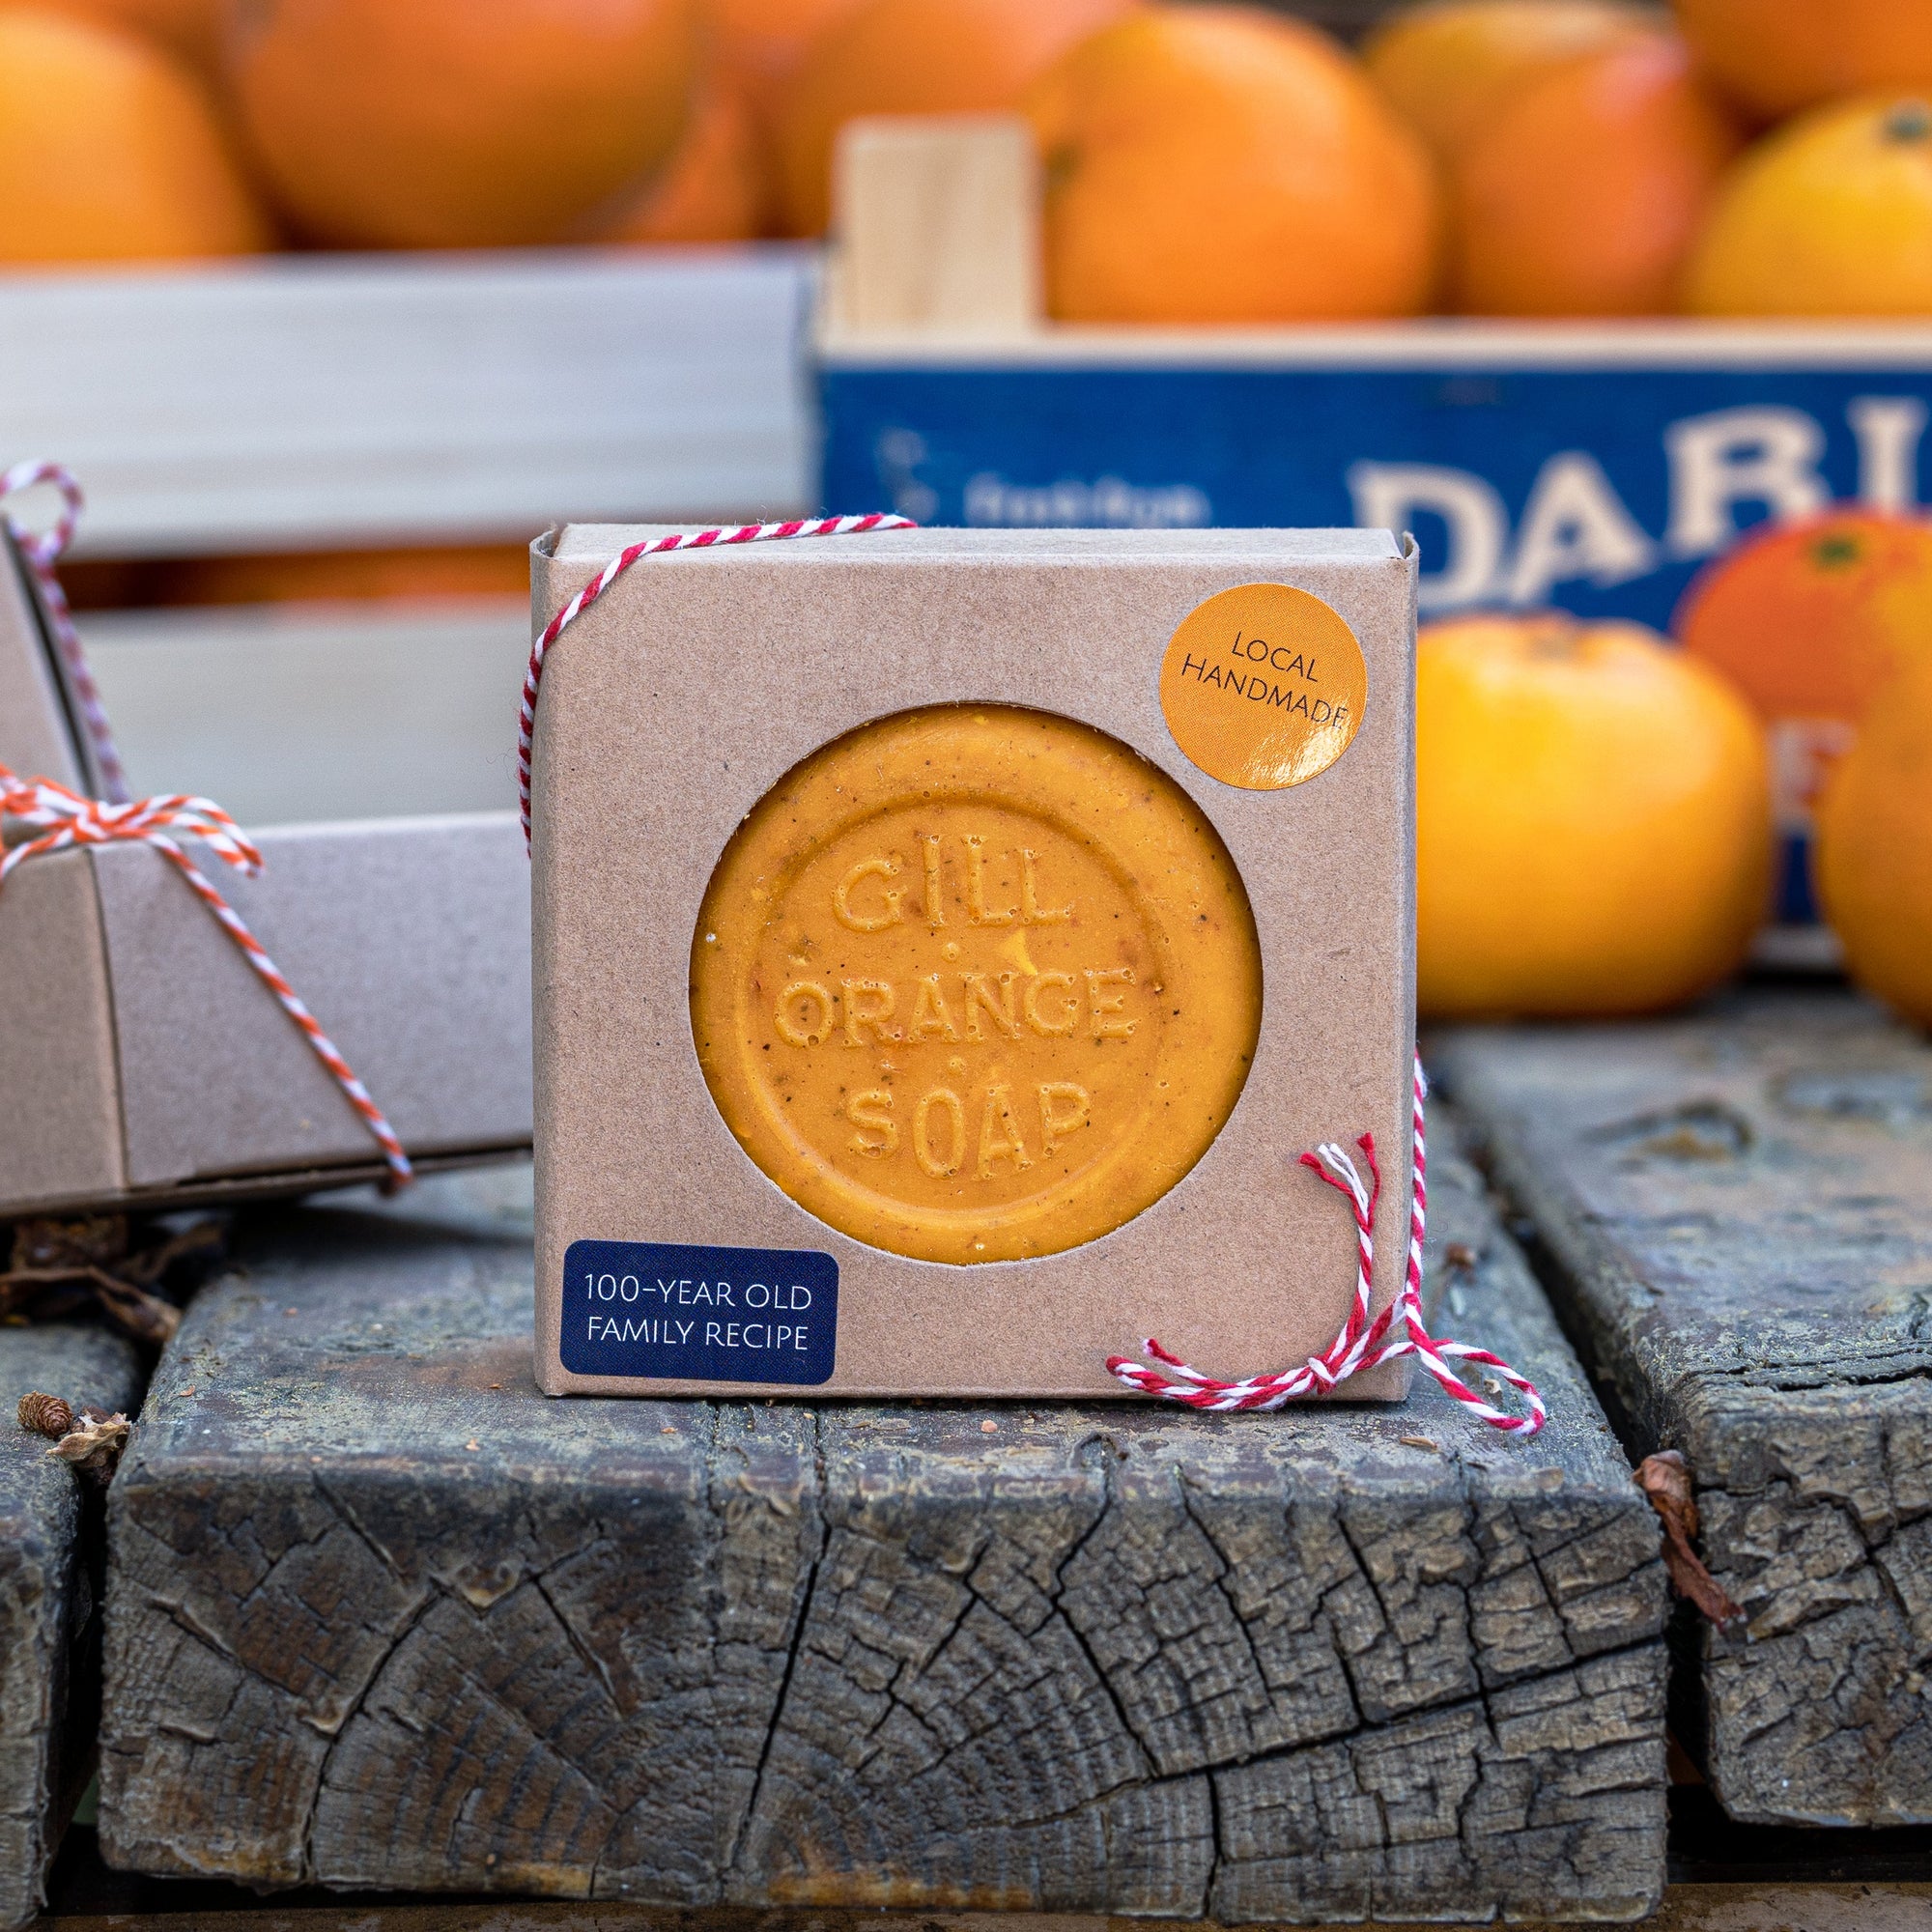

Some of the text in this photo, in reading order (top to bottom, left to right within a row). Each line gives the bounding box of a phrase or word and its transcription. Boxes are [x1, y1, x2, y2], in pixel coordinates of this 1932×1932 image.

[1181, 653, 1349, 729] HANDMADE
[1232, 631, 1318, 682] LOCAL
[833, 834, 1074, 931] GILL
[774, 969, 1141, 1047] ORANGE
[846, 1082, 1092, 1181] SOAP
[584, 1273, 812, 1310] 100-YEAR OLD
[587, 1317, 809, 1350] FAMILY RECIPE
